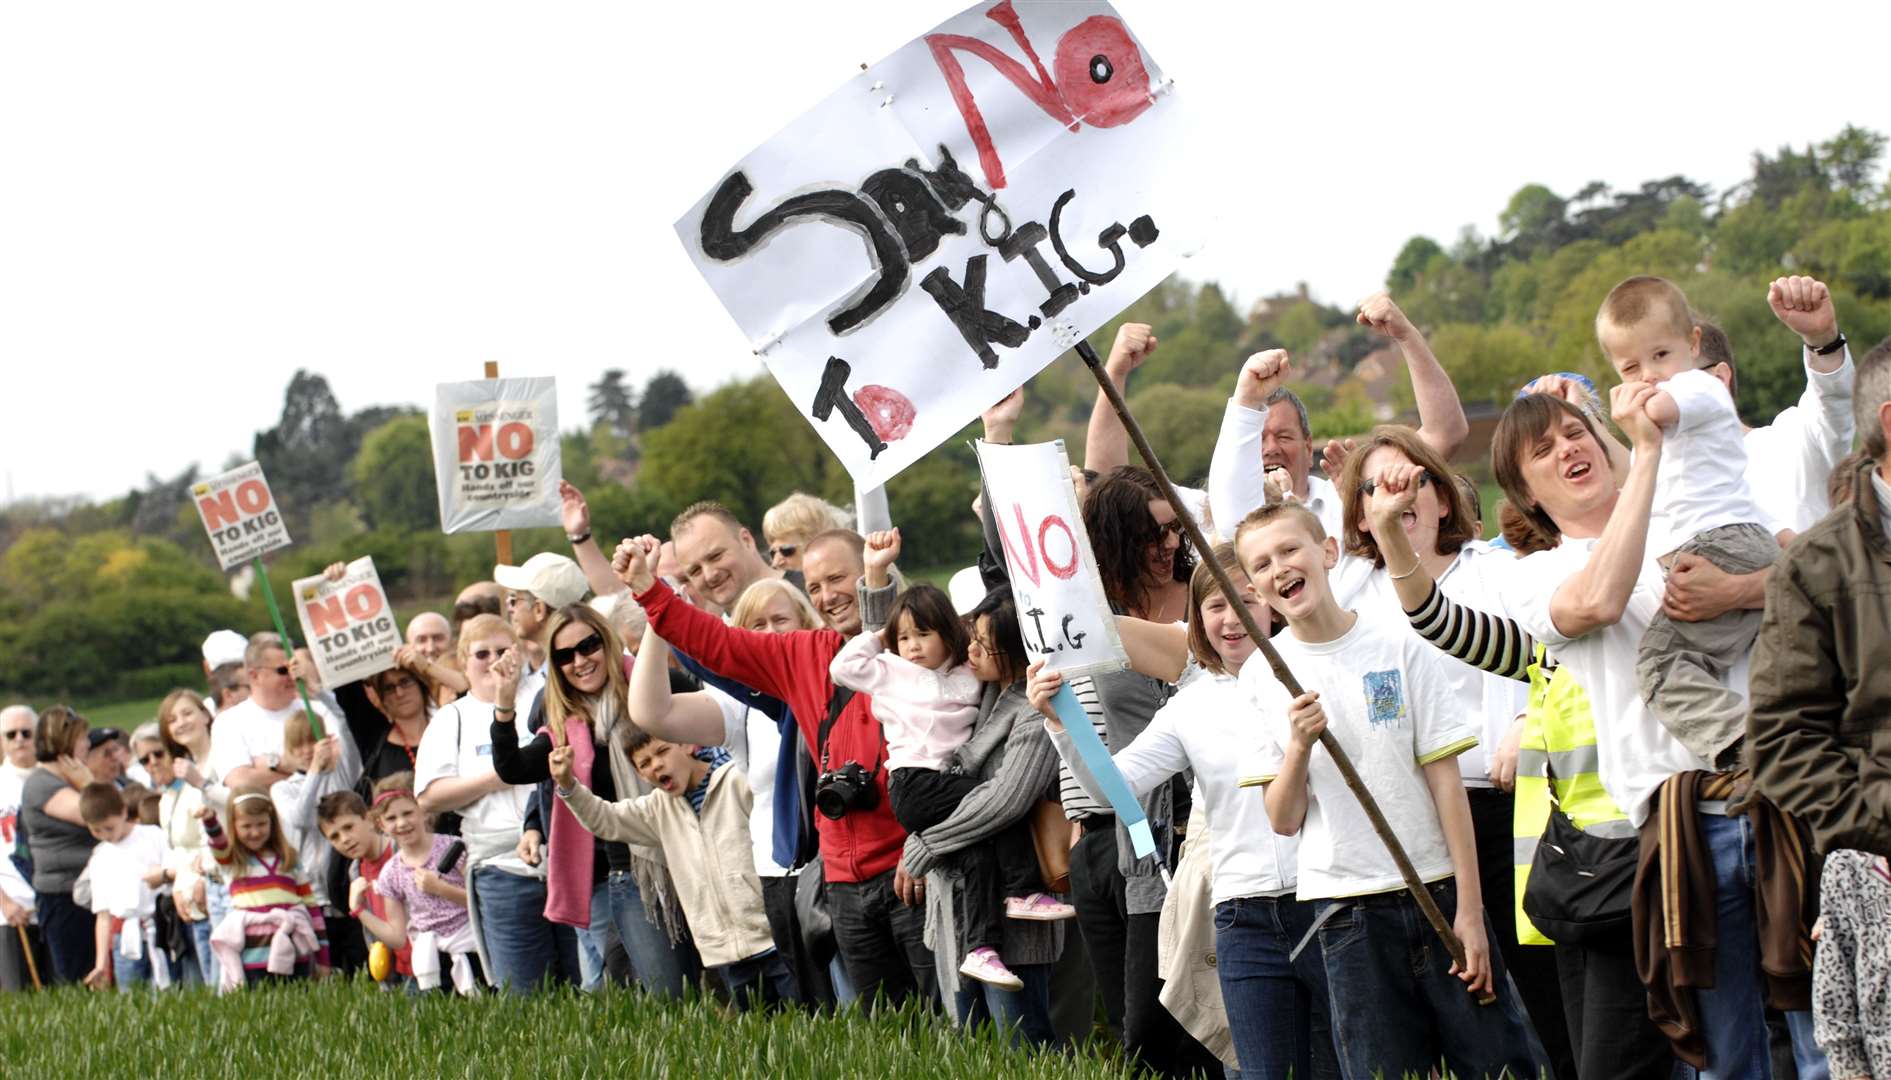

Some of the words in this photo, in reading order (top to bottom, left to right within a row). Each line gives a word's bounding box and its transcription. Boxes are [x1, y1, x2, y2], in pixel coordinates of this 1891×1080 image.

[700, 142, 1011, 337] Say
[457, 421, 535, 462] NO
[460, 464, 490, 480] TO
[494, 461, 535, 479] KIG
[462, 483, 494, 491] Hands
[499, 481, 513, 489] off
[199, 480, 270, 533] NO
[213, 526, 241, 545] TO
[243, 511, 279, 535] KIG
[305, 583, 383, 637] NO
[318, 634, 348, 653] TO
[351, 617, 391, 641] KIG
[1023, 608, 1087, 654] .I.G
[326, 647, 358, 663] Hands
